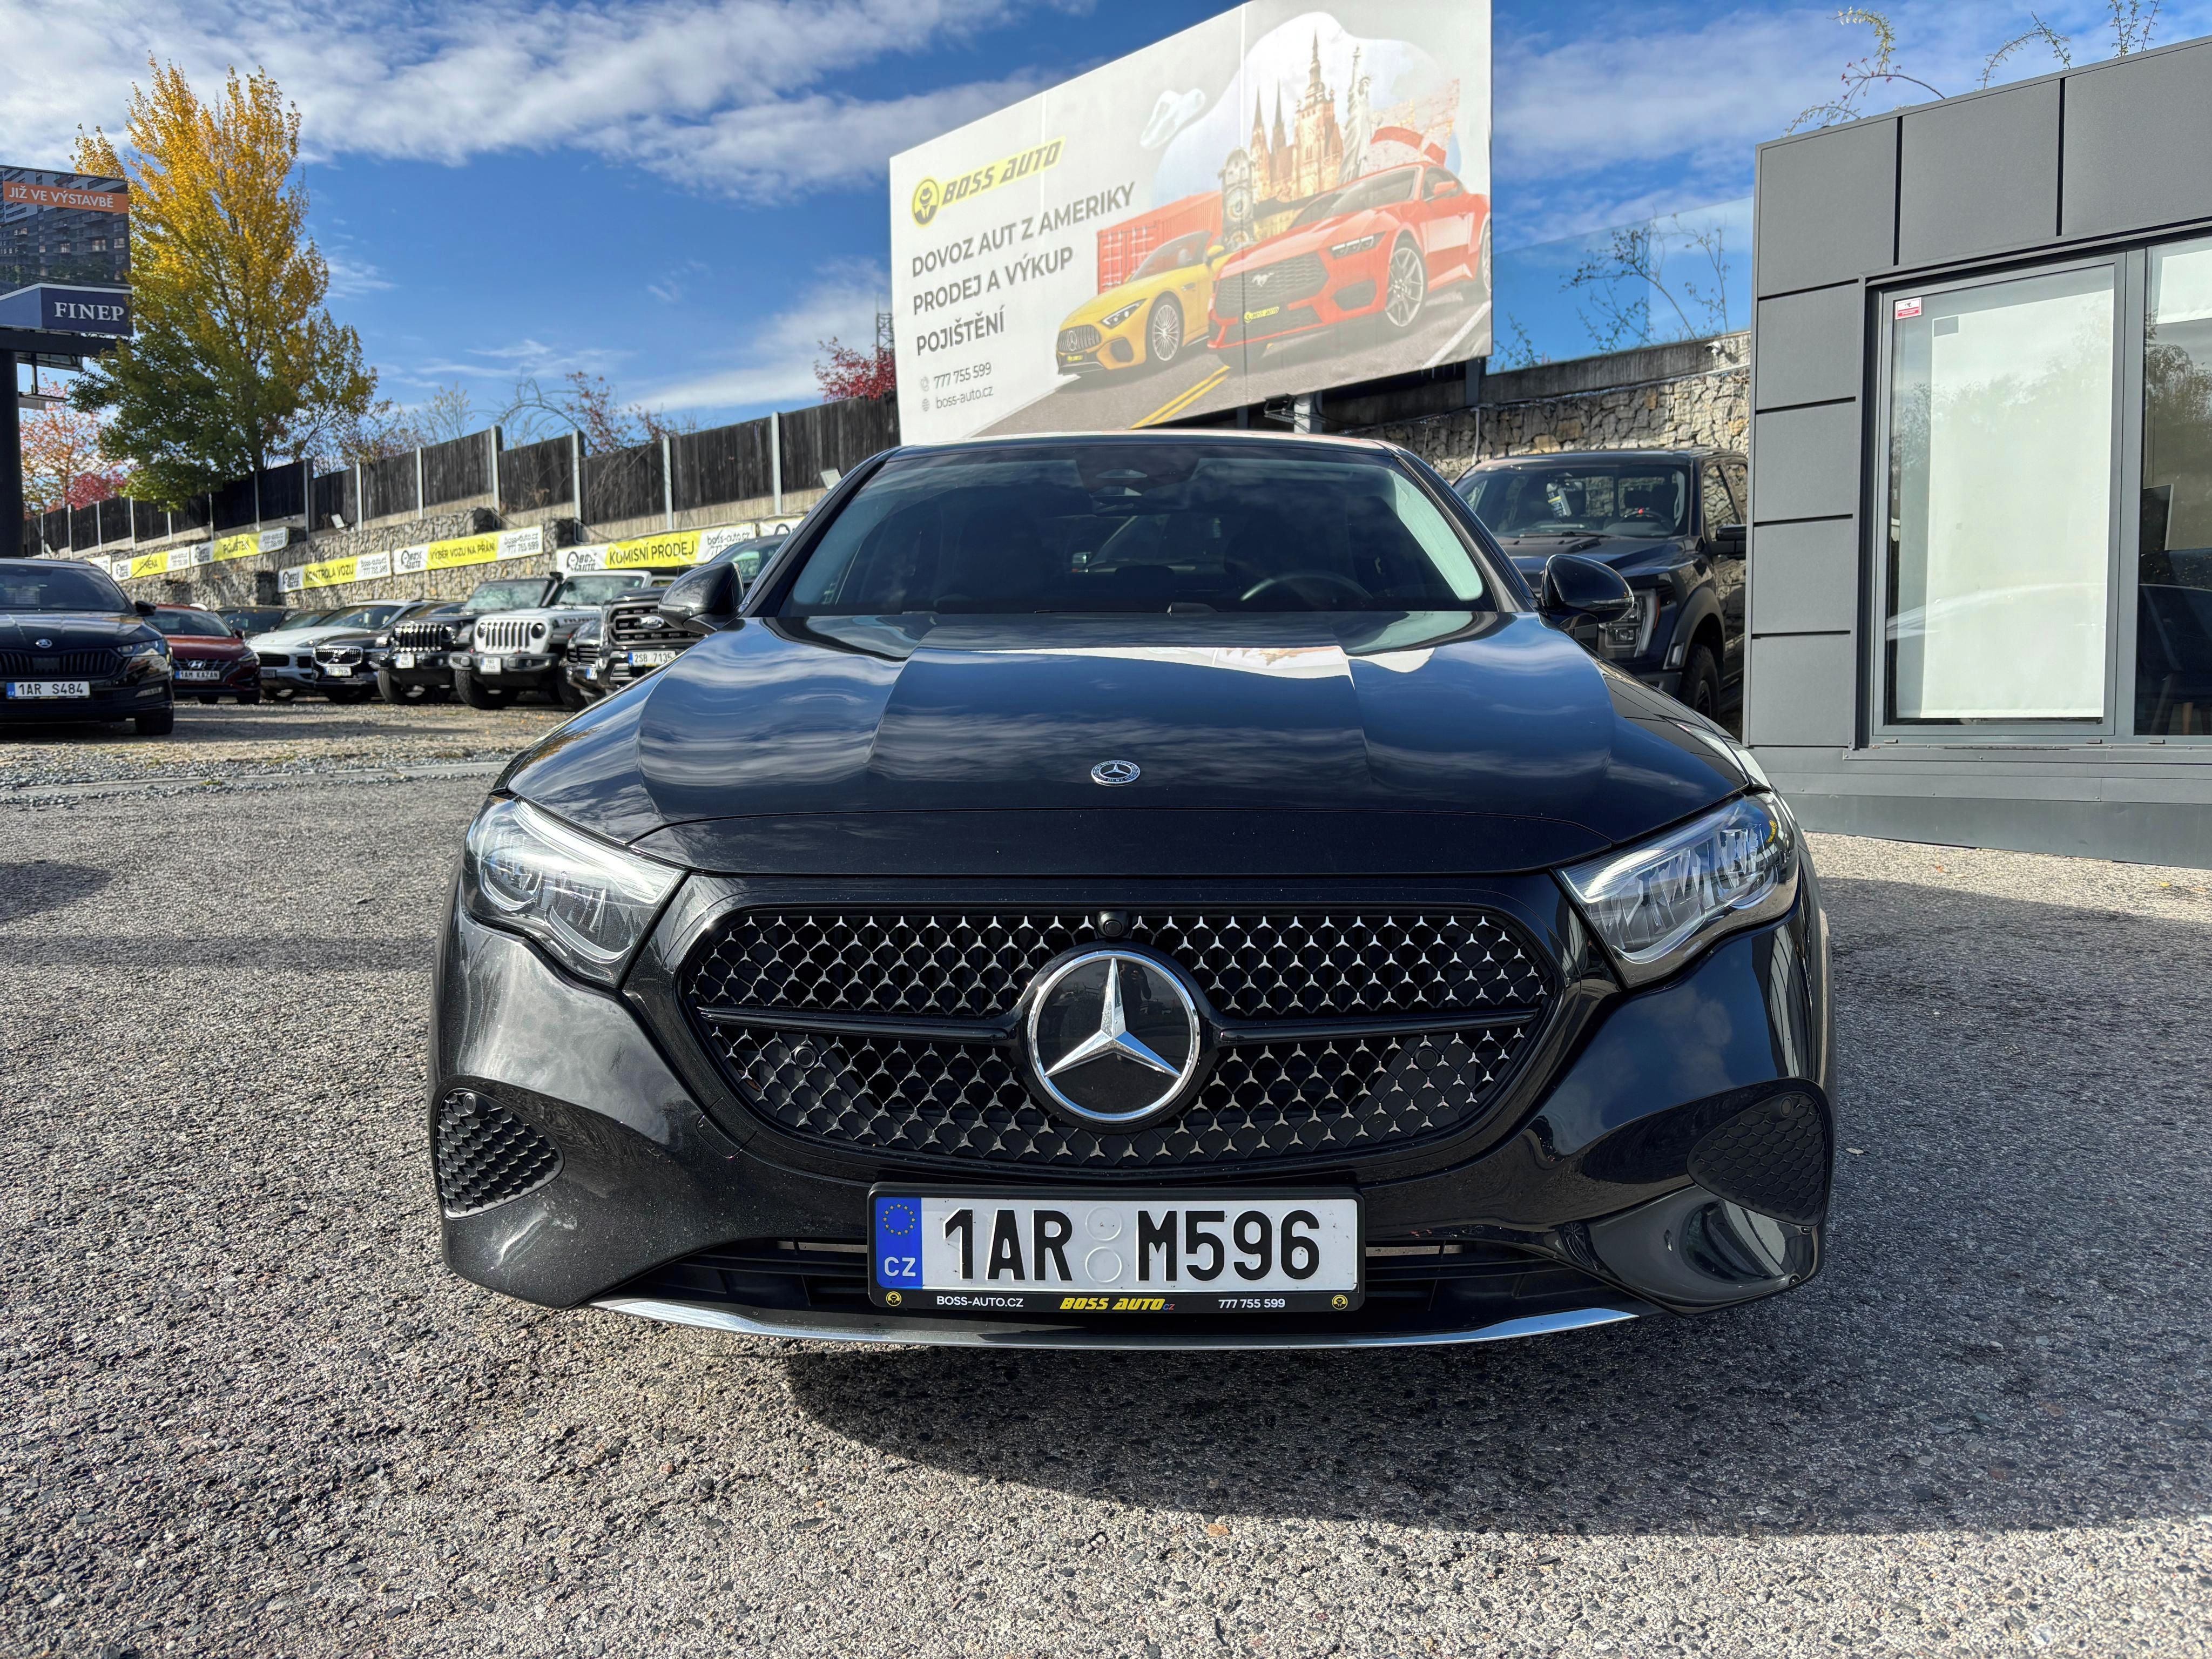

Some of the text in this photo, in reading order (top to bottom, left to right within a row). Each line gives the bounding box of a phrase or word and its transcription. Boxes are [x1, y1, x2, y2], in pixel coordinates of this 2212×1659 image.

[941, 140, 1062, 206] BOSS AUTO
[9, 185, 114, 208] JIŽ VE VÝSTAVBĚ
[913, 181, 1135, 278] DOVOZ AUT Z AMERIKY
[913, 246, 1074, 315] PRODEJ A VÝKUP
[54, 302, 125, 321] FINEP
[916, 304, 1006, 356] POJIŠTĚNÍ
[934, 362, 992, 389] 777 755 599
[936, 386, 994, 409] boss-auto.cz
[707, 532, 750, 545] boss-auto.cz
[450, 547, 466, 557] VOZU
[467, 545, 476, 555] NA
[610, 541, 694, 565] KOMISNÍ PRODEJ
[338, 563, 354, 576] VOZU
[18, 683, 83, 695] 1AR S484
[943, 1208, 1321, 1282] 1AR M596
[884, 1257, 916, 1277] CZ
[936, 1296, 1024, 1307] BOSS-AUTO.CZ
[1060, 1297, 1109, 1310] BOSS
[1218, 1298, 1286, 1309] 777 755 599
